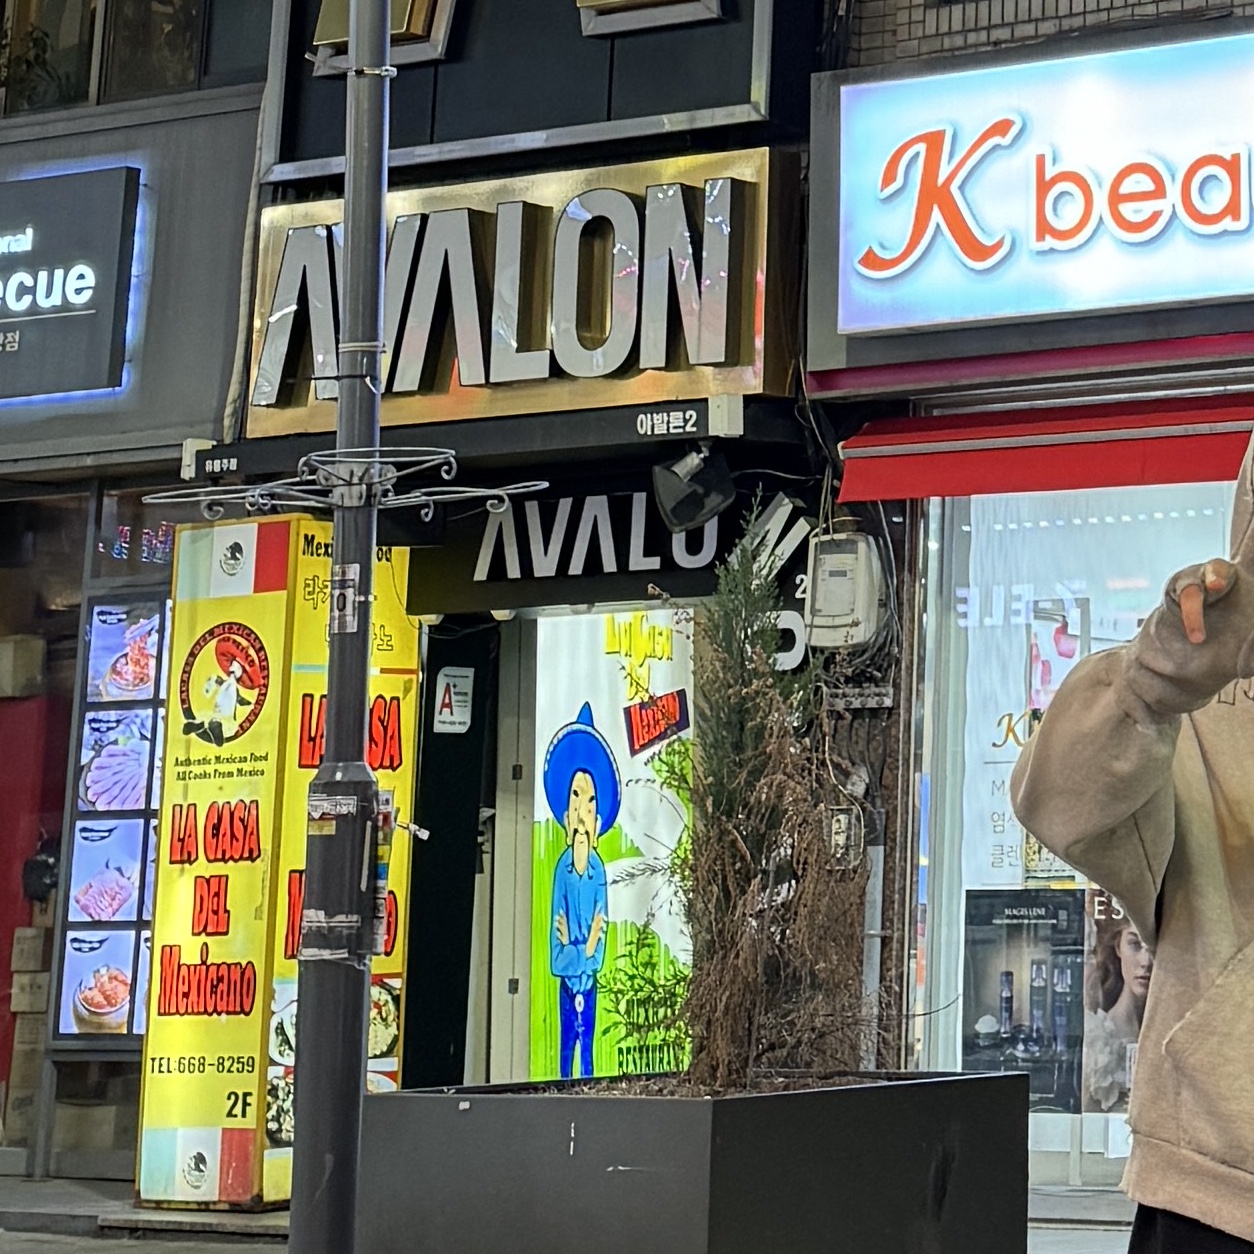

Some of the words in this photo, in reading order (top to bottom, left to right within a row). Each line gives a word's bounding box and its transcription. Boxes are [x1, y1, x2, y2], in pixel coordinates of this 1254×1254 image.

[857, 118, 1020, 274] K
[636, 410, 698, 435] 아발론2
[991, 712, 1032, 749] K
[249, 752, 269, 764] Food
[169, 803, 199, 865] LA
[203, 799, 262, 864] CASA
[191, 874, 230, 936] DEL
[157, 942, 257, 1017] Mexicano
[150, 1055, 256, 1075] TEL:668-8259
[225, 1091, 254, 1119] 2F
